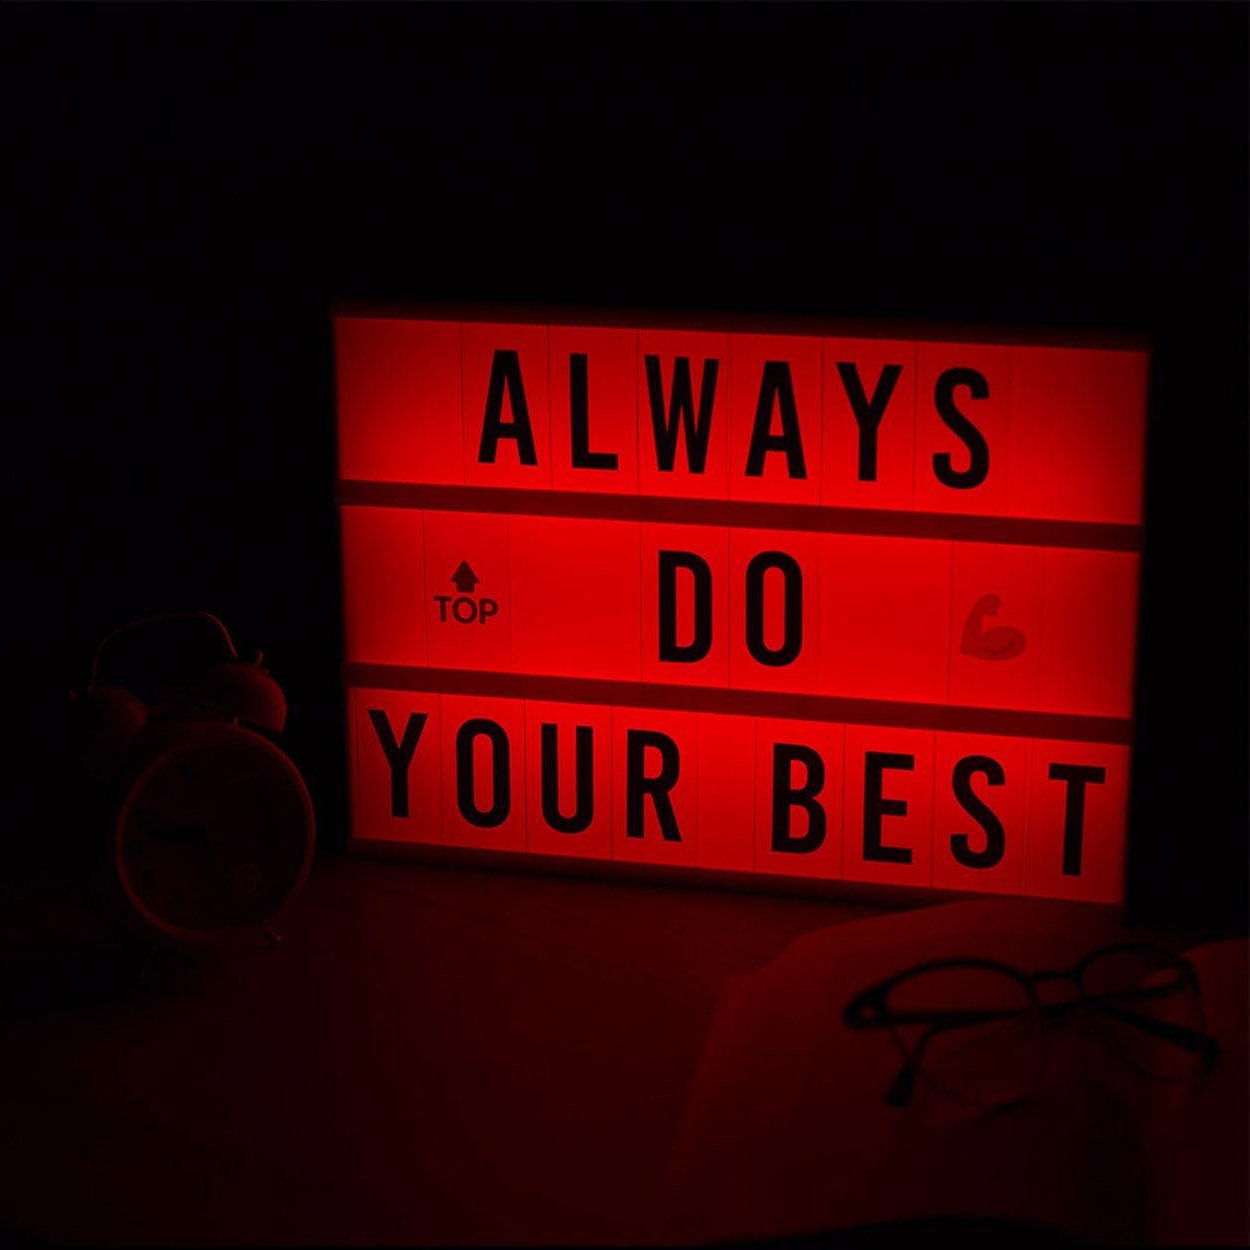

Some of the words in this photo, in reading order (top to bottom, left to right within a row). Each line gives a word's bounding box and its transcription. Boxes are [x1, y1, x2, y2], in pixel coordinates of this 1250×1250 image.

[478, 350, 990, 489] ALWAYS
[434, 596, 498, 624] TOP
[659, 550, 802, 666] DO
[367, 709, 682, 843] YOUR
[772, 744, 1106, 879] BEST
